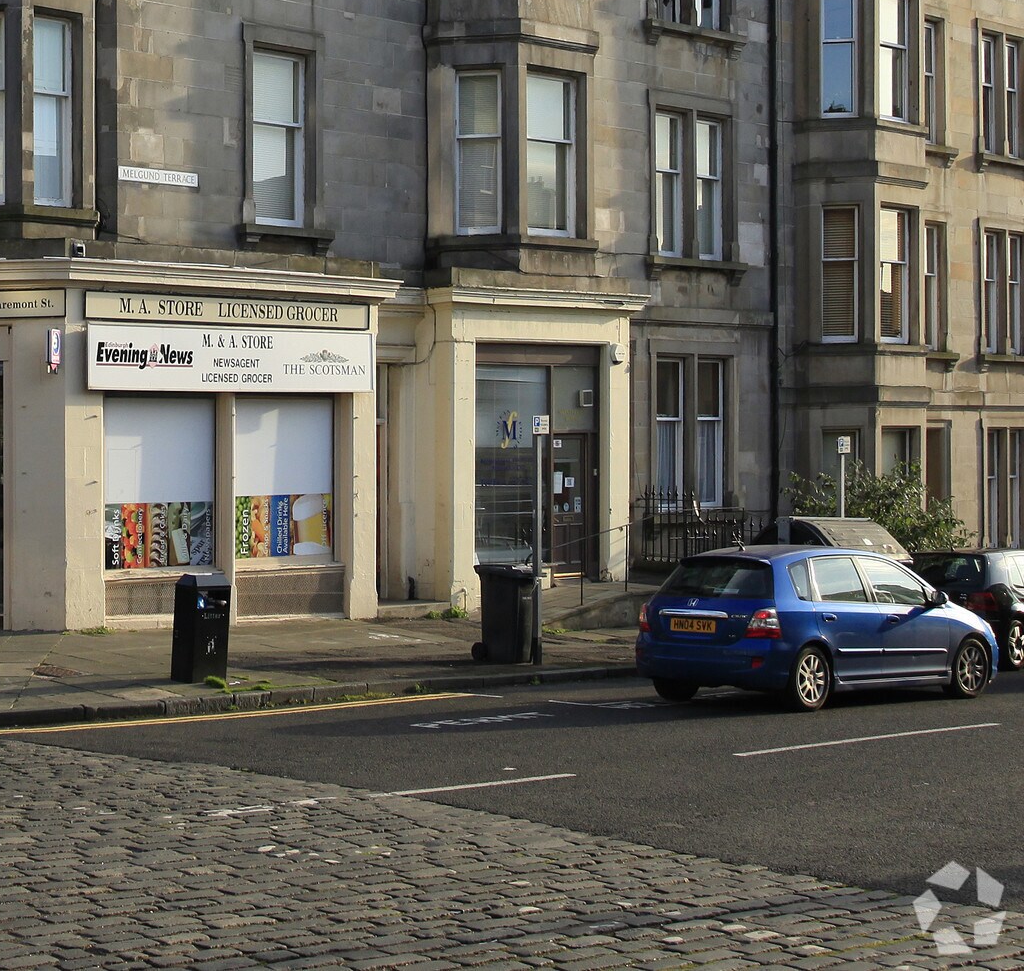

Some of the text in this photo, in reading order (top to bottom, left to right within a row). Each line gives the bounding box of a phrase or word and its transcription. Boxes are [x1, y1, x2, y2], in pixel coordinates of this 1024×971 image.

[122, 169, 195, 185] MELGUND TERRACE
[41, 298, 54, 309] St.
[119, 297, 338, 322] M. A. STORE LICENSED GROCER
[202, 334, 273, 350] M. & A. STORE
[96, 342, 193, 369] Evening News
[213, 358, 260, 368] NEWSAGENT
[201, 373, 273, 383] LICENSED GROCER
[283, 364, 366, 376] THE SCOTSMAN
[136, 508, 145, 564] Confectionery
[240, 509, 249, 554] Frozen
[112, 541, 120, 566] Soft
[203, 612, 221, 620] Litter
[673, 619, 712, 631] HN04 SVK
